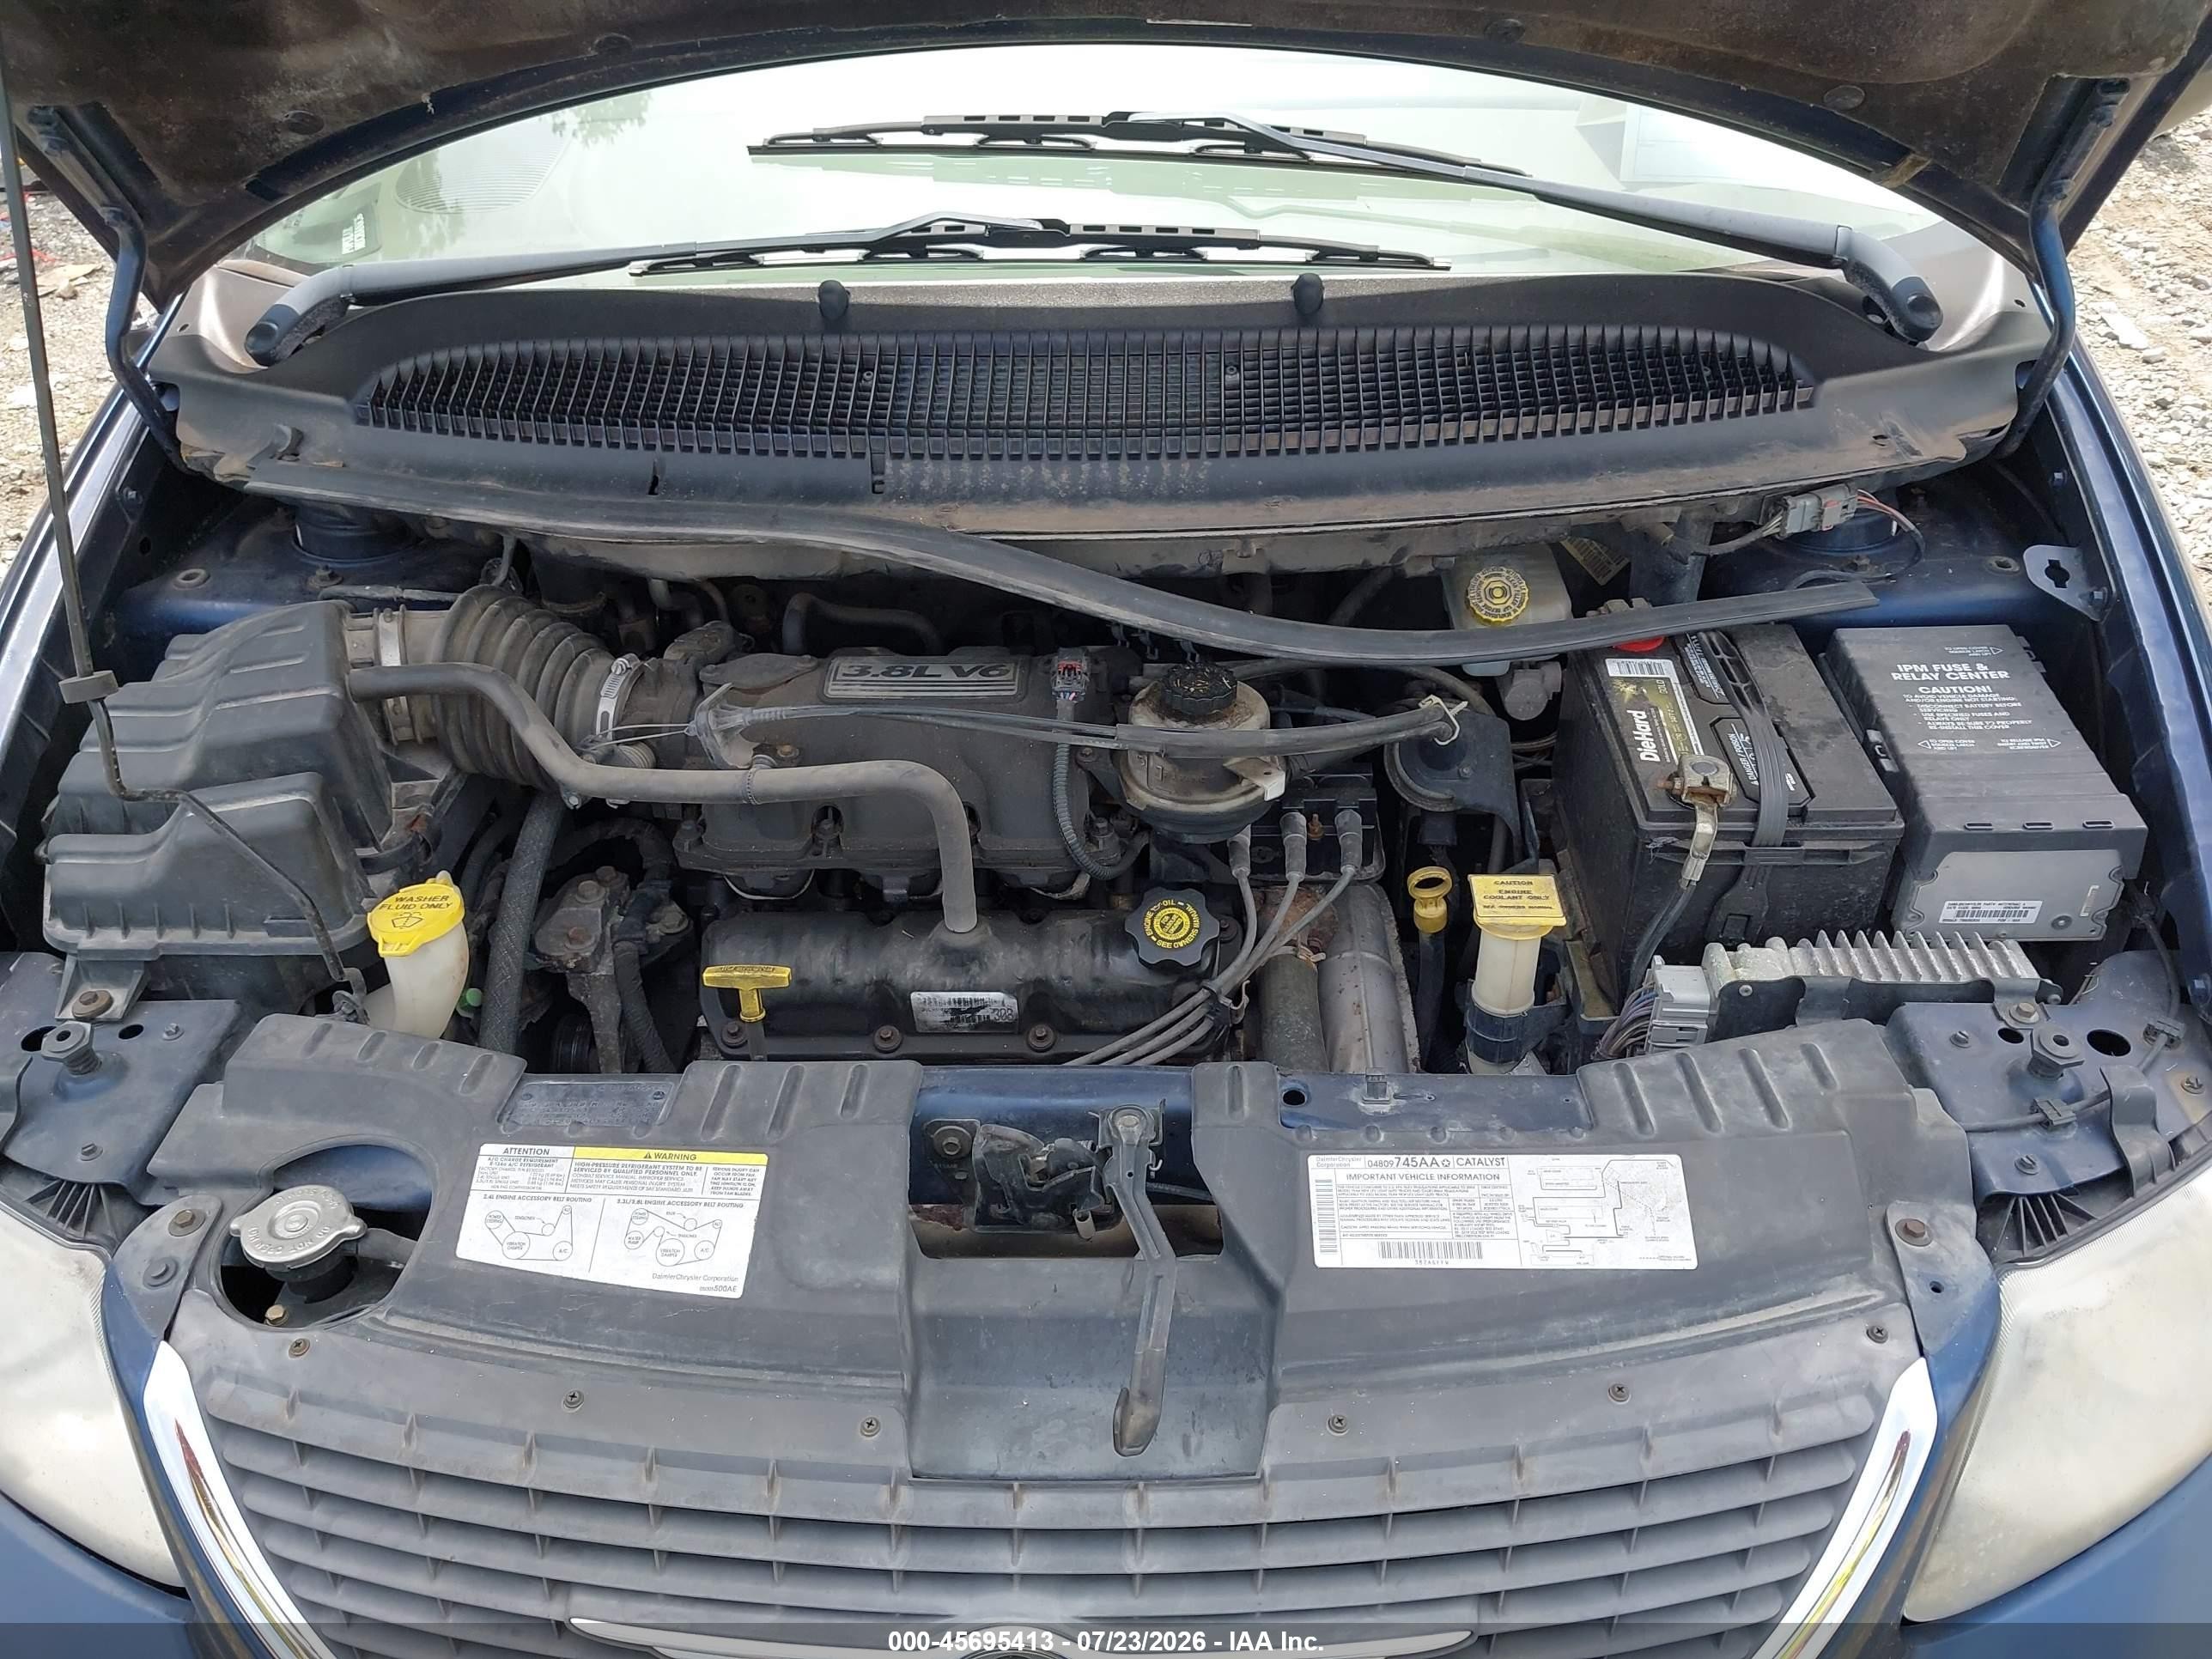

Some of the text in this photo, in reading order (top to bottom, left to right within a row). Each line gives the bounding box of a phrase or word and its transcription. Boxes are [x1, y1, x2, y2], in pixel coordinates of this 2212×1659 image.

[842, 663, 1010, 678] 3.8L V6
[1896, 664, 1929, 672] IPM
[1931, 663, 1972, 672] FUSE
[1891, 671, 2011, 681] RELAY CENTER
[1917, 685, 1993, 694] CAUTION!
[1626, 710, 1661, 762] DieHard
[1144, 910, 1154, 936] ENGINE
[1156, 902, 1200, 949] SEE OWNERS MANUAL
[502, 1147, 550, 1156] ATTENTION
[653, 1152, 697, 1161] WARNING
[1456, 1158, 1505, 1167] CATALYST
[652, 1273, 702, 1281] DaimlerChrysler
